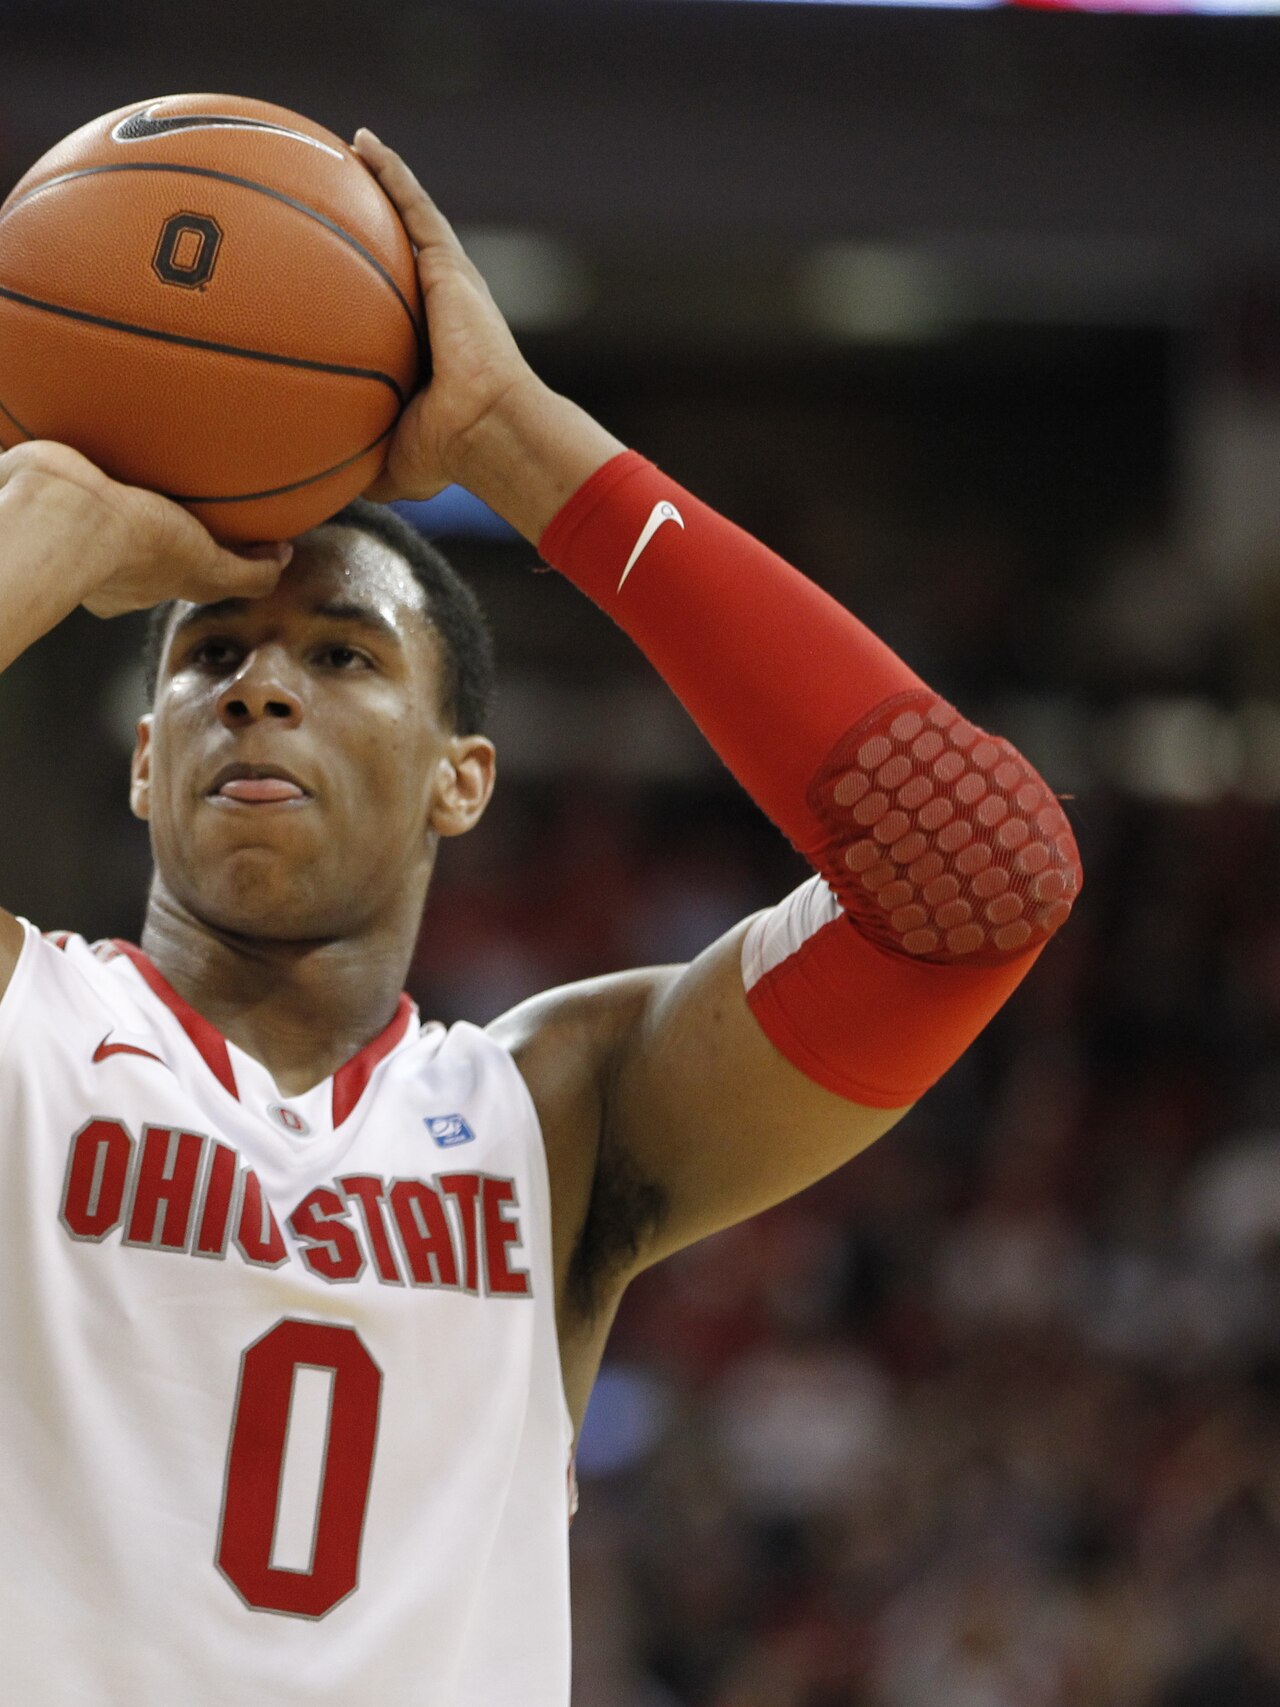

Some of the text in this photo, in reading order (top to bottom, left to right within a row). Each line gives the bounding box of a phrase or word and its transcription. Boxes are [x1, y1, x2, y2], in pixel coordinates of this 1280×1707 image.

[151, 210, 223, 290] O
[59, 1116, 532, 1299] OHIO STATE
